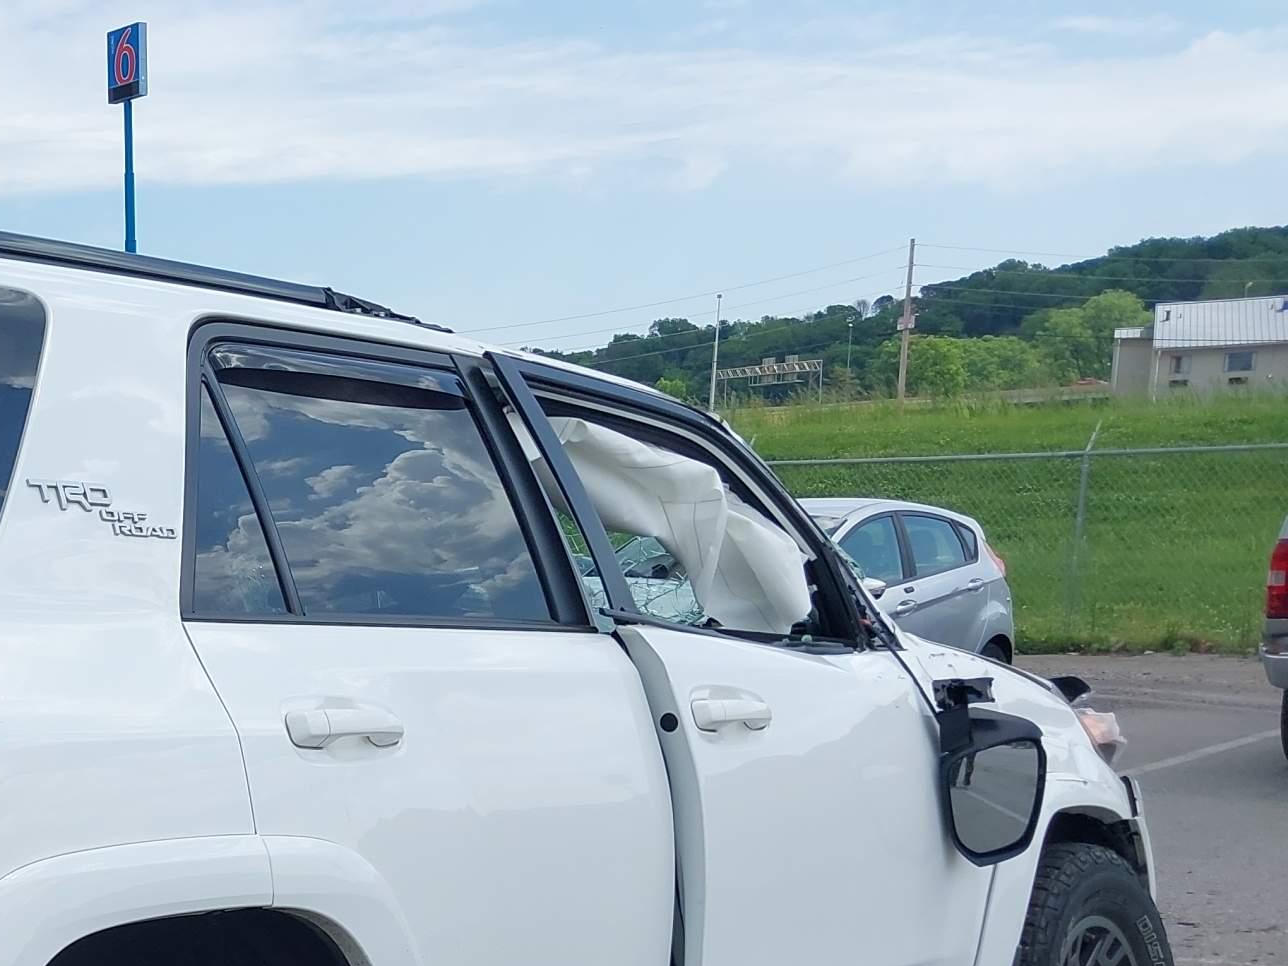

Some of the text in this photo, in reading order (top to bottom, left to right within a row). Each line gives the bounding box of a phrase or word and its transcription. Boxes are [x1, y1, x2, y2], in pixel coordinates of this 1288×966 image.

[114, 27, 136, 86] 6
[26, 479, 112, 512] TRD
[100, 509, 149, 524] OFF
[112, 523, 177, 539] ROAD
